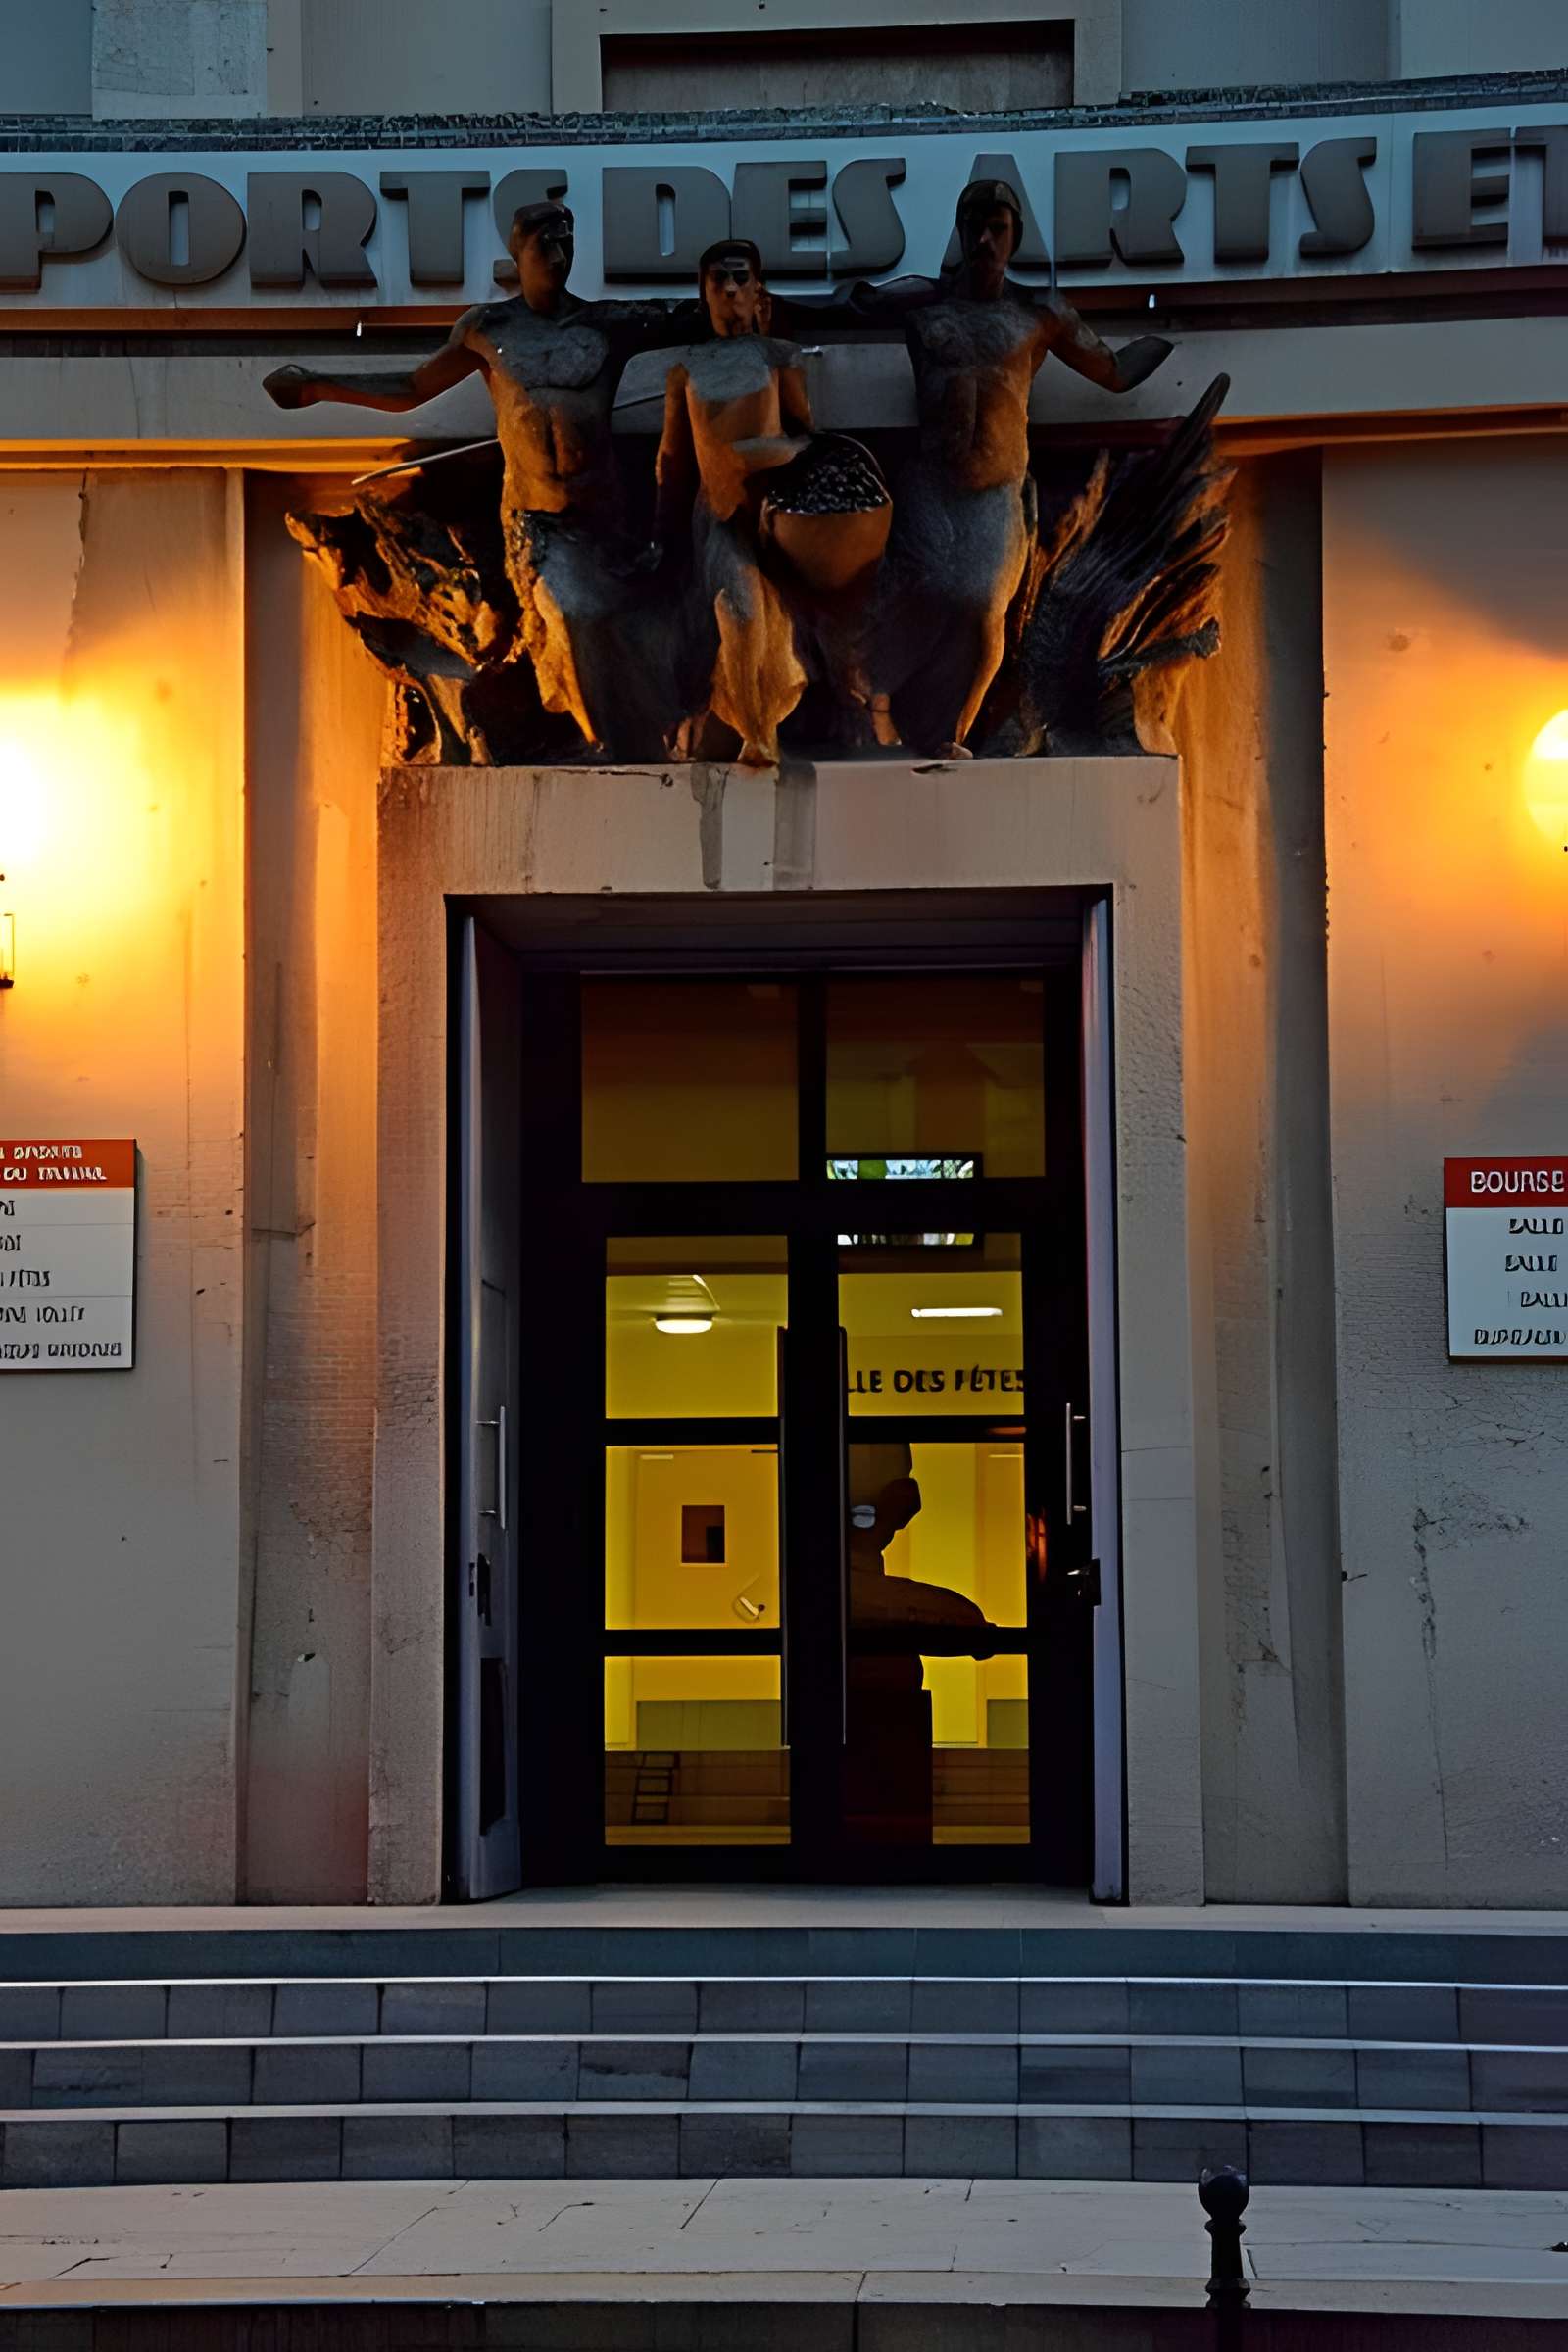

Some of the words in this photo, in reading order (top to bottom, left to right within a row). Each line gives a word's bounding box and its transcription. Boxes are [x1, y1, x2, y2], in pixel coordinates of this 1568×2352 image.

[603, 157, 906, 284] DES
[941, 137, 1377, 273] ARTS
[1471, 1170, 1565, 1193] BOURSE
[848, 1370, 883, 1393] LE
[893, 1369, 945, 1393] DES
